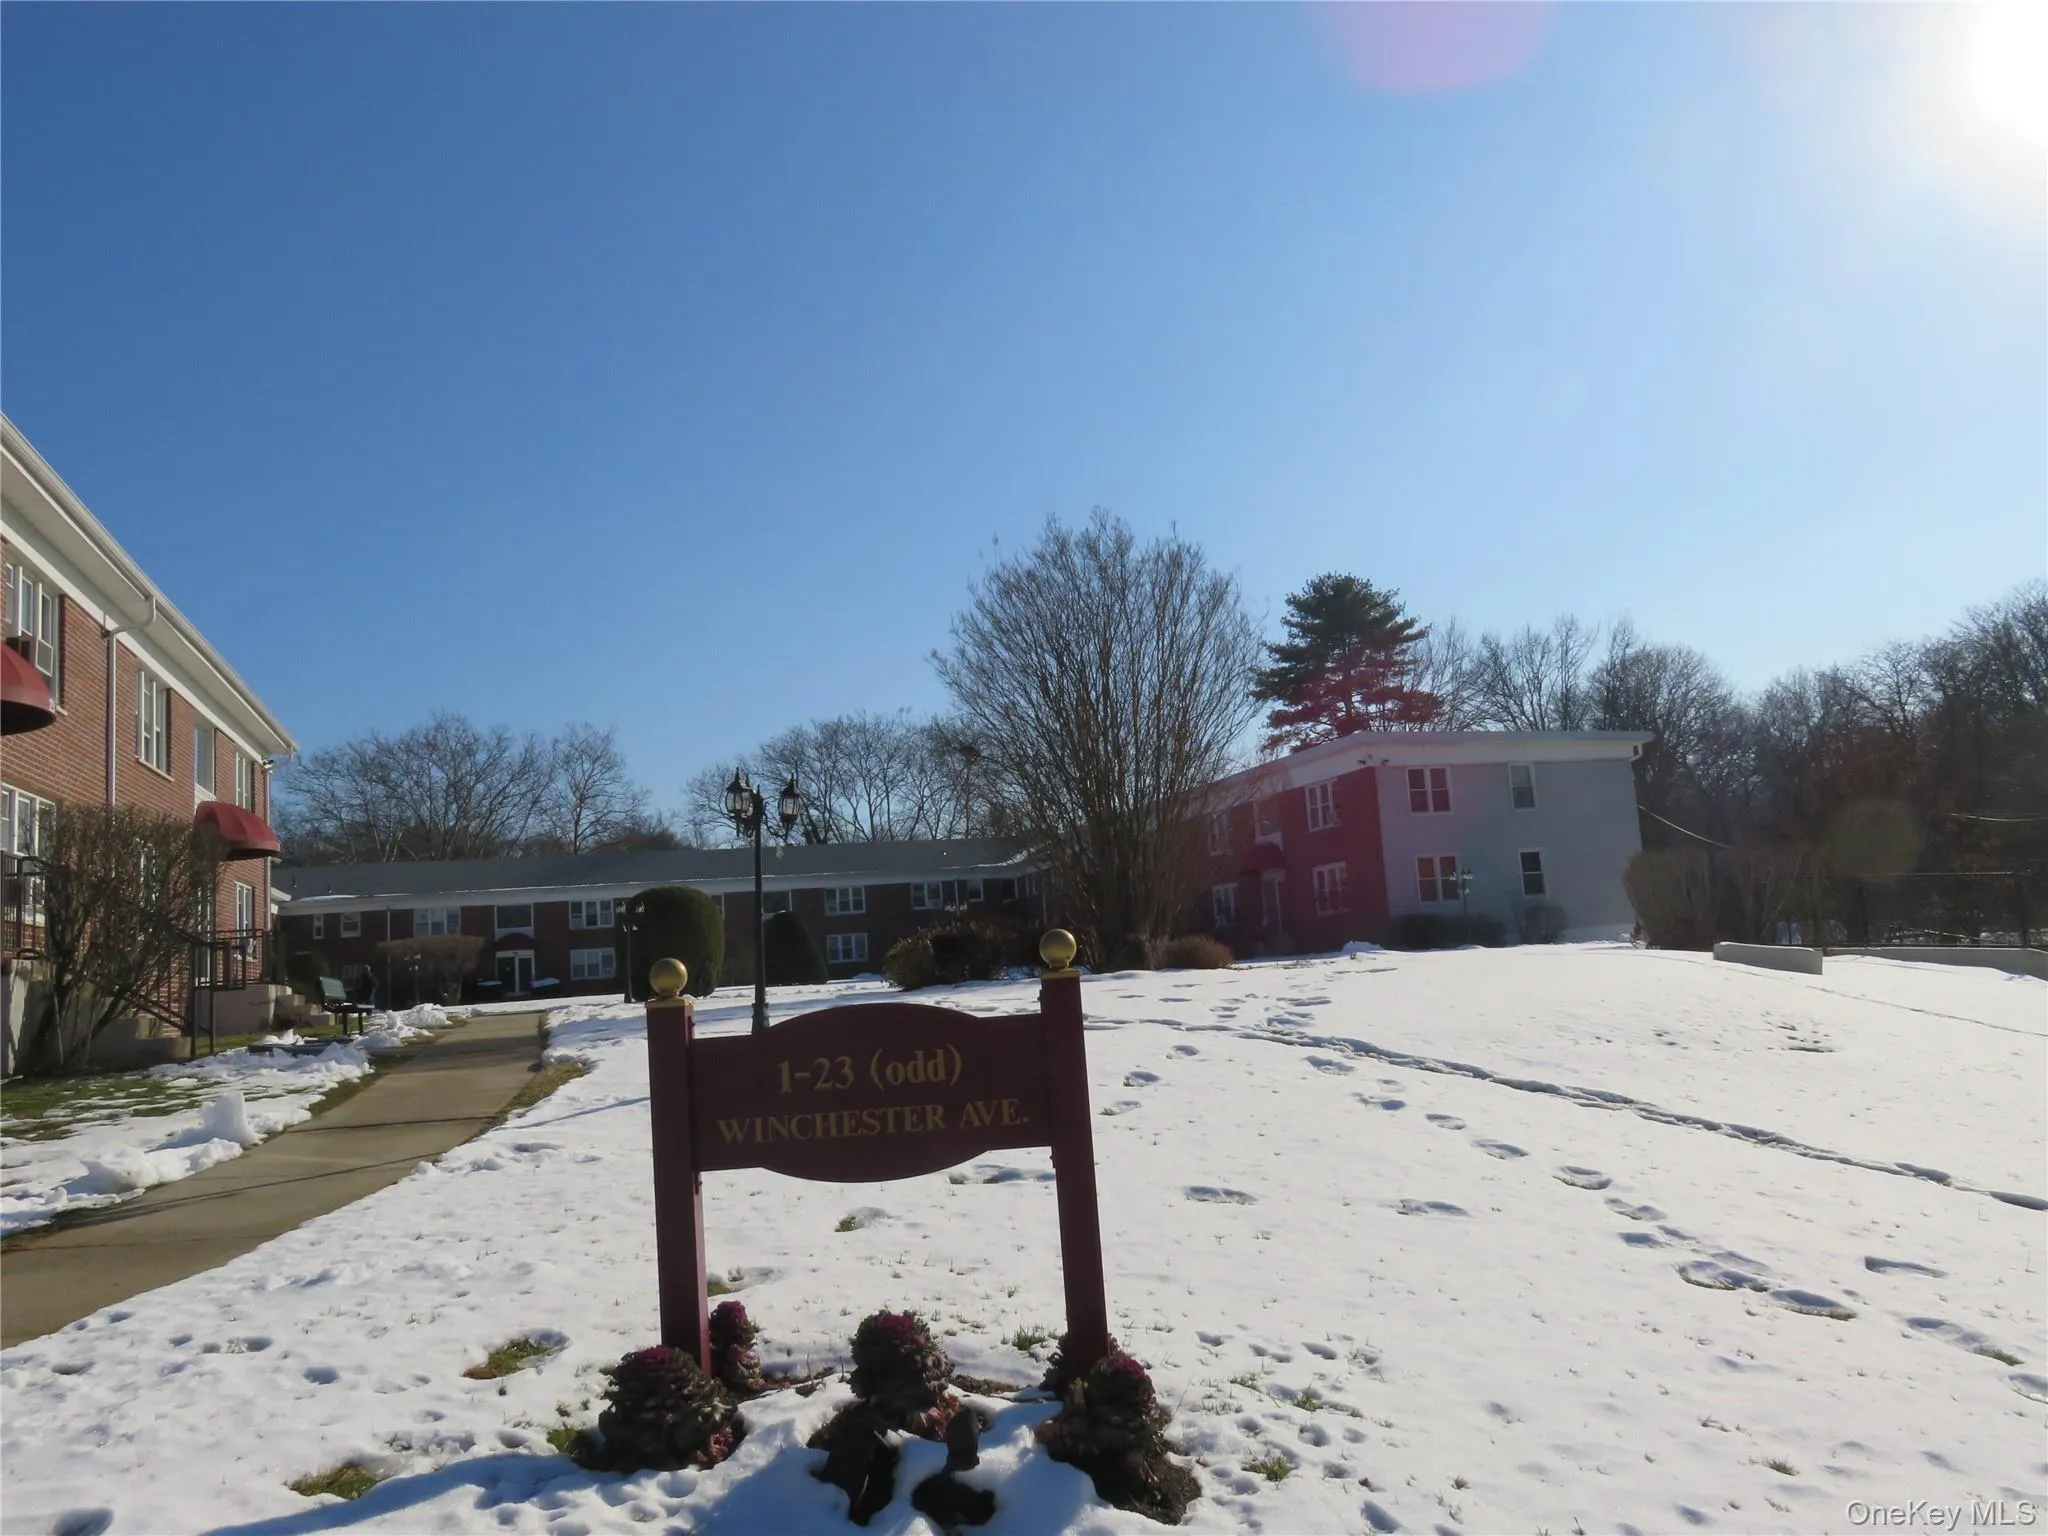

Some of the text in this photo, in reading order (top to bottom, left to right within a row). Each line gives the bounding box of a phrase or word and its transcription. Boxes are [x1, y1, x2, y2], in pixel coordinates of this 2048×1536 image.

[777, 1043, 962, 1093] 1-23 (odd)
[717, 1098, 1029, 1144] WINCHESTER AVE.
